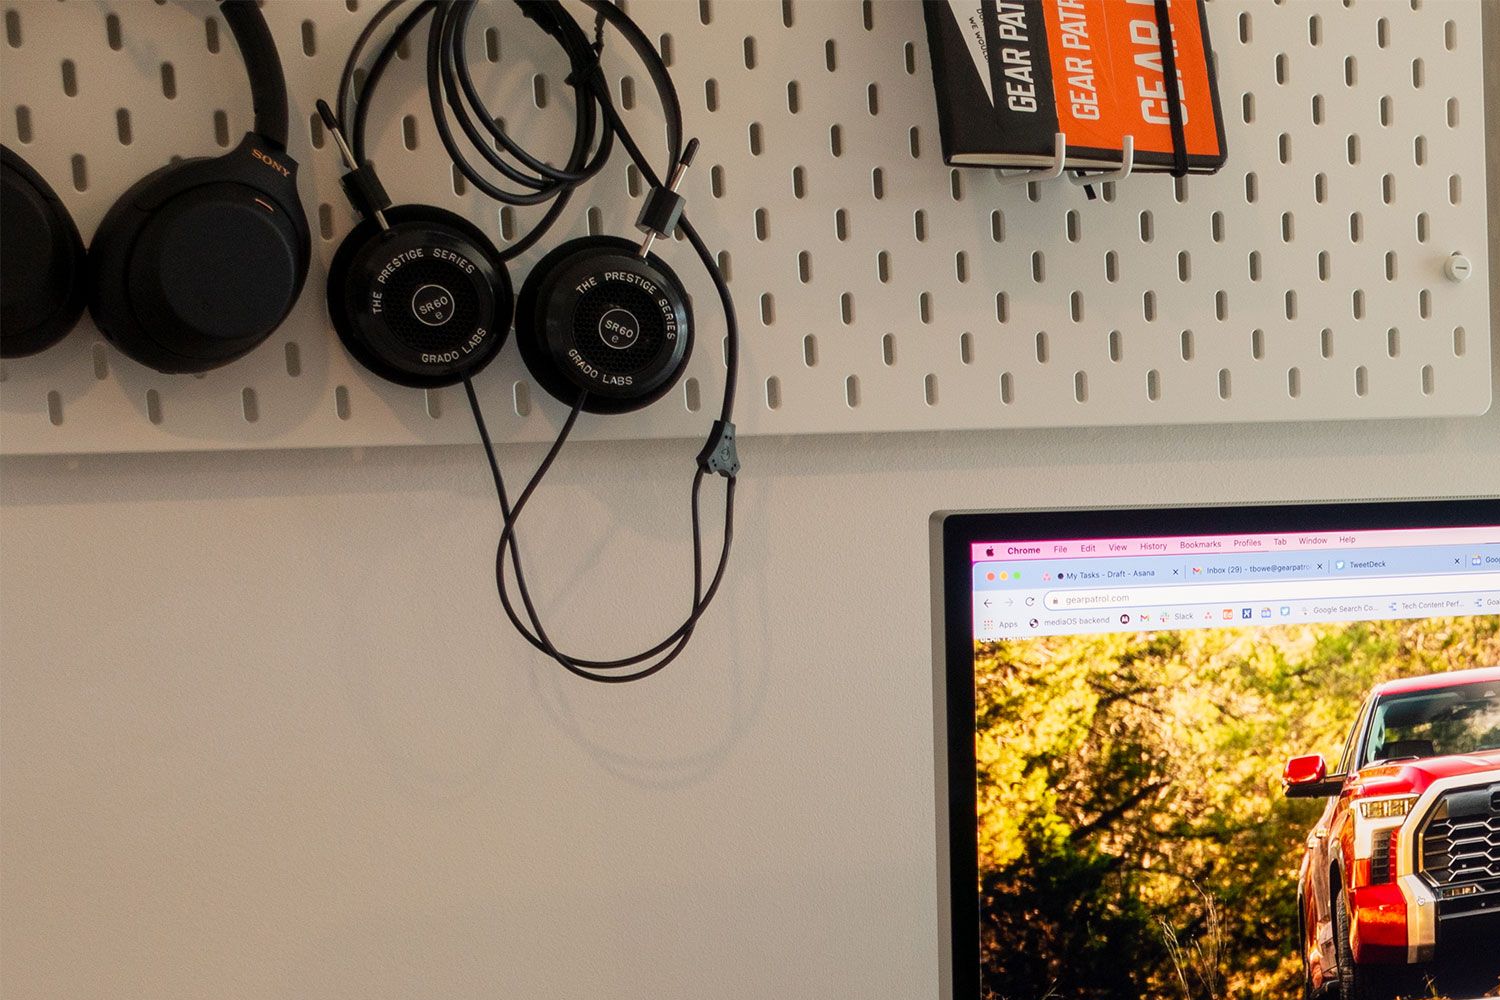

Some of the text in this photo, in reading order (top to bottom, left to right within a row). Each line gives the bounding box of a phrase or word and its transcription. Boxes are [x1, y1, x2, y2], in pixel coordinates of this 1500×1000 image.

[969, 16, 979, 30] WE
[1002, 47, 1038, 113] GEAR
[1065, 56, 1101, 121] GEAR
[252, 149, 290, 177] SONY
[372, 248, 476, 314] THE PRESTIGE SERIES
[419, 296, 449, 315] SR60
[575, 271, 676, 340] THE PRESTIGE SERIES
[604, 320, 634, 338] SR60
[421, 327, 487, 363] GRADO LABS
[568, 349, 633, 386] GRADO LABS
[1007, 536, 1356, 555] Chrome File Edit View History Bookmarks Profiles Tab Window Help
[1207, 566, 1226, 574] Inbox
[1350, 560, 1386, 569] TweetDeck
[1066, 569, 1155, 581] My Tasks Draft Asana
[1066, 593, 1130, 605] gearpatrol.com
[1402, 602, 1417, 610] Tech
[1418, 601, 1445, 609] Content
[1486, 598, 1500, 606] Goal
[1174, 611, 1194, 620] Slack
[1313, 606, 1338, 615] Google
[1339, 604, 1363, 613] Search
[999, 621, 1018, 630] Apps
[1044, 617, 1110, 627] mediaOS backend
